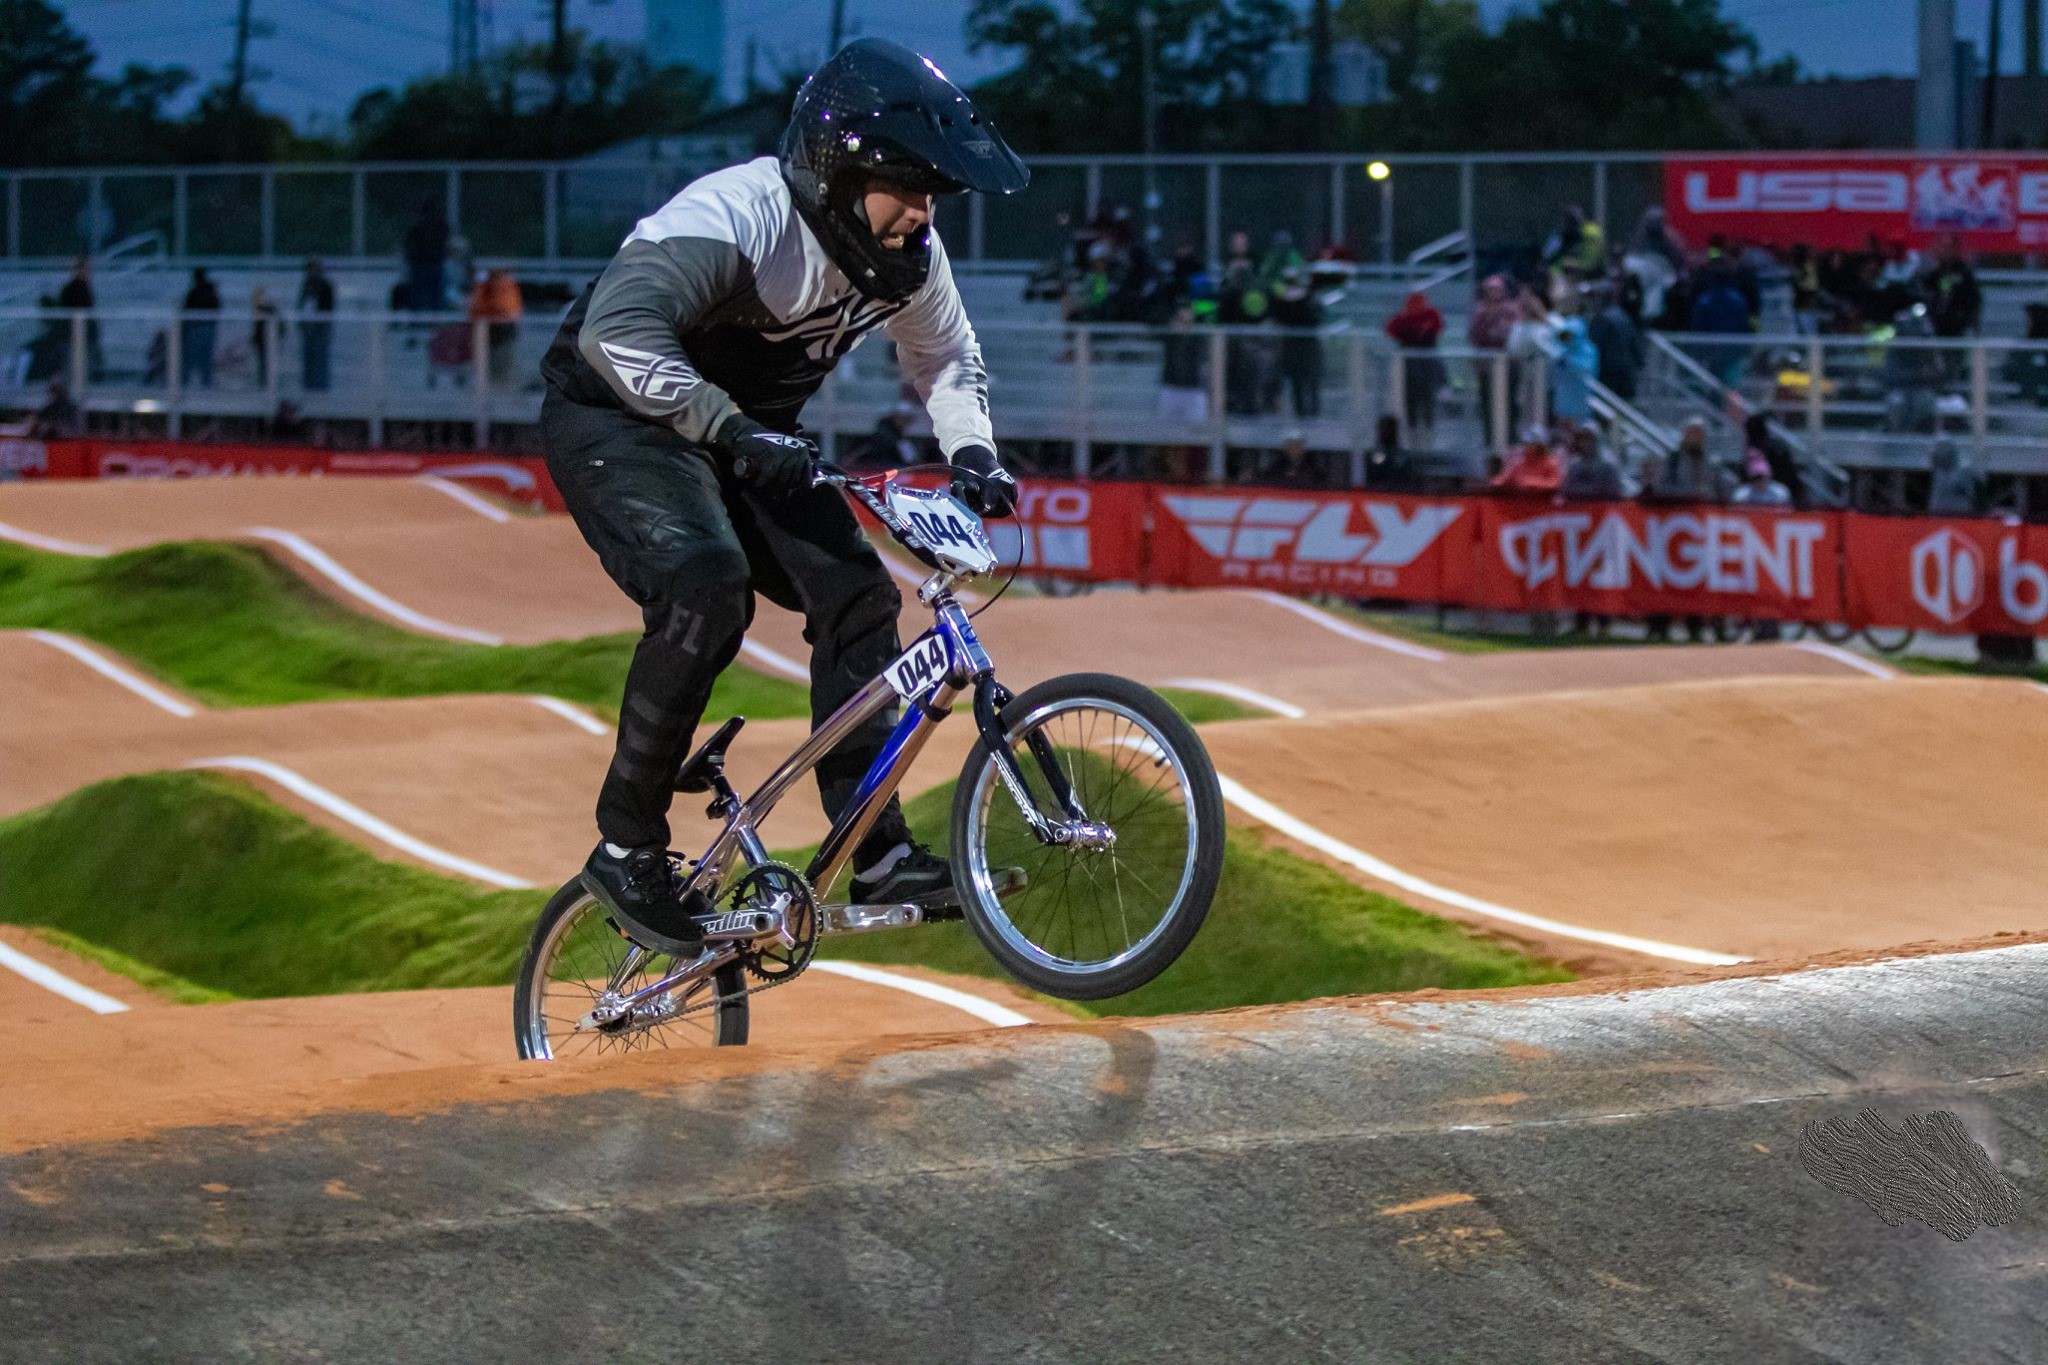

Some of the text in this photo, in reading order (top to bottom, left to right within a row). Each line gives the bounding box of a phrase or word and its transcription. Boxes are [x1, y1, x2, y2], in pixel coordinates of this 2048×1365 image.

[908, 512, 977, 549] 044
[1160, 497, 1463, 567] FLY
[1221, 561, 1397, 586] RACING
[898, 638, 944, 694] 044
[702, 911, 758, 934] edlin
